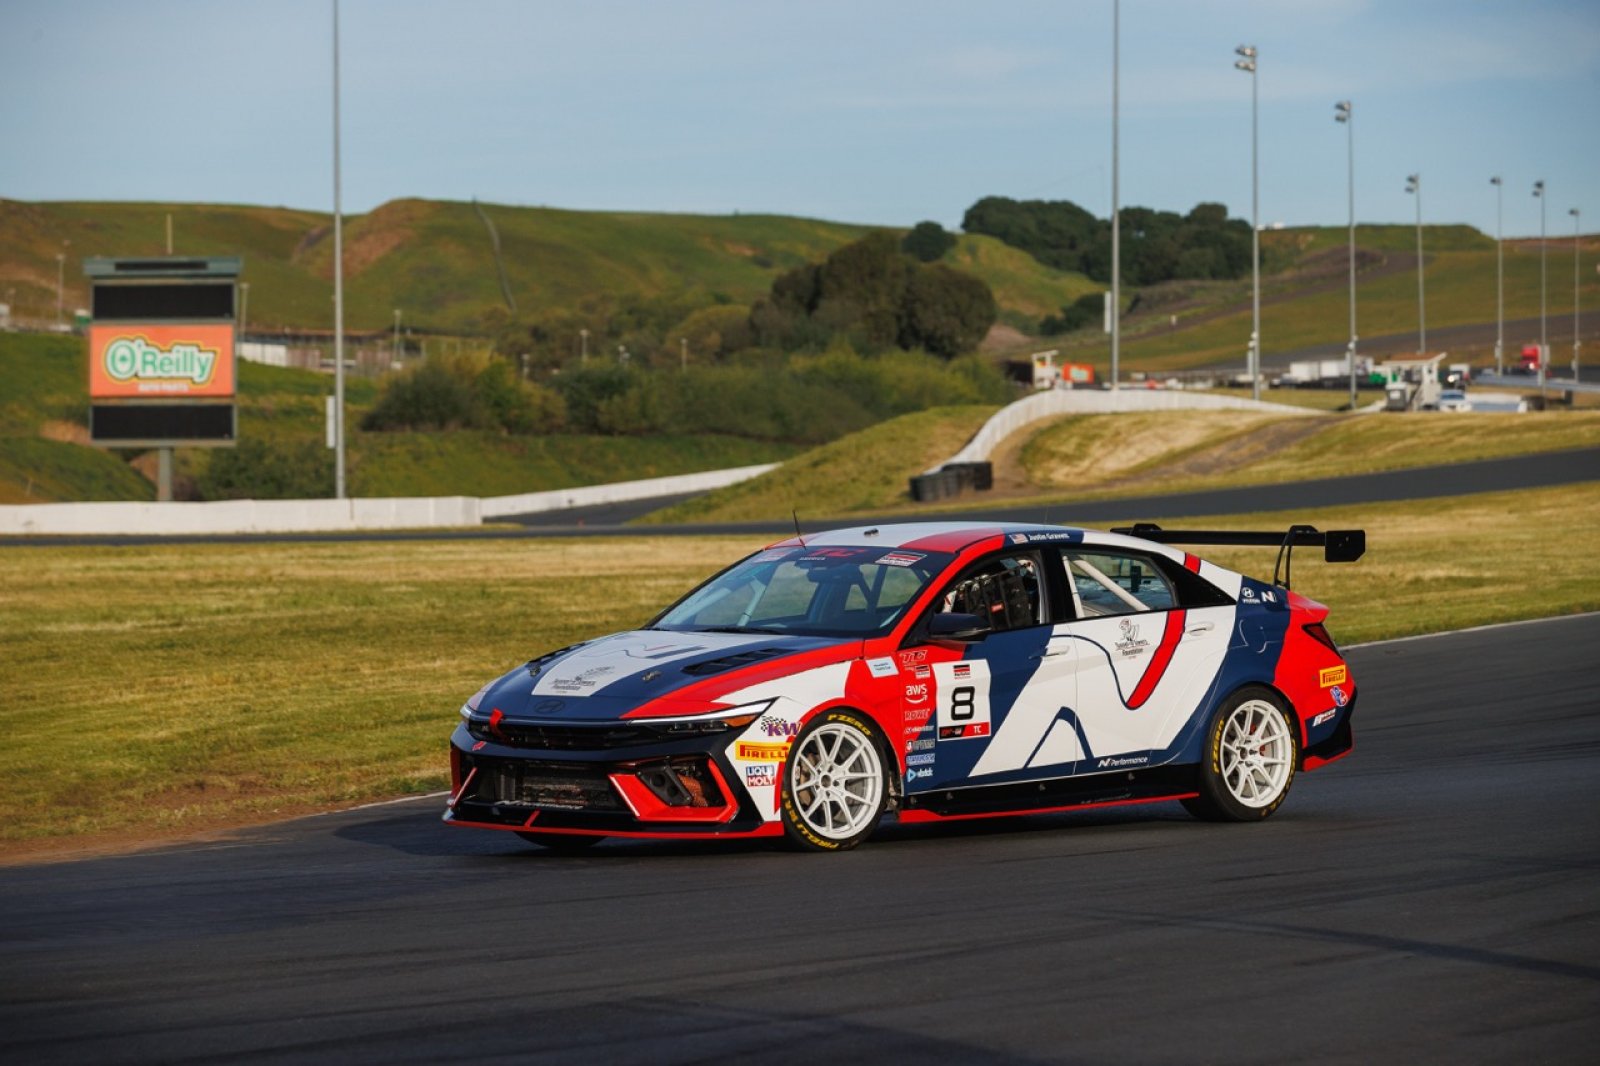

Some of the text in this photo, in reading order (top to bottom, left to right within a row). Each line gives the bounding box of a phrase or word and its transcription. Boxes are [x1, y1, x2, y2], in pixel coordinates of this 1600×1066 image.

[108, 340, 211, 379] O'Reilly
[906, 684, 928, 696] aws
[950, 686, 975, 721] 8
[904, 709, 929, 721] ROWE
[767, 722, 800, 737] KW
[973, 725, 983, 734] TC
[739, 744, 789, 759] PIRELLI
[1110, 756, 1149, 767] Performance
[747, 776, 775, 787] MOLY
